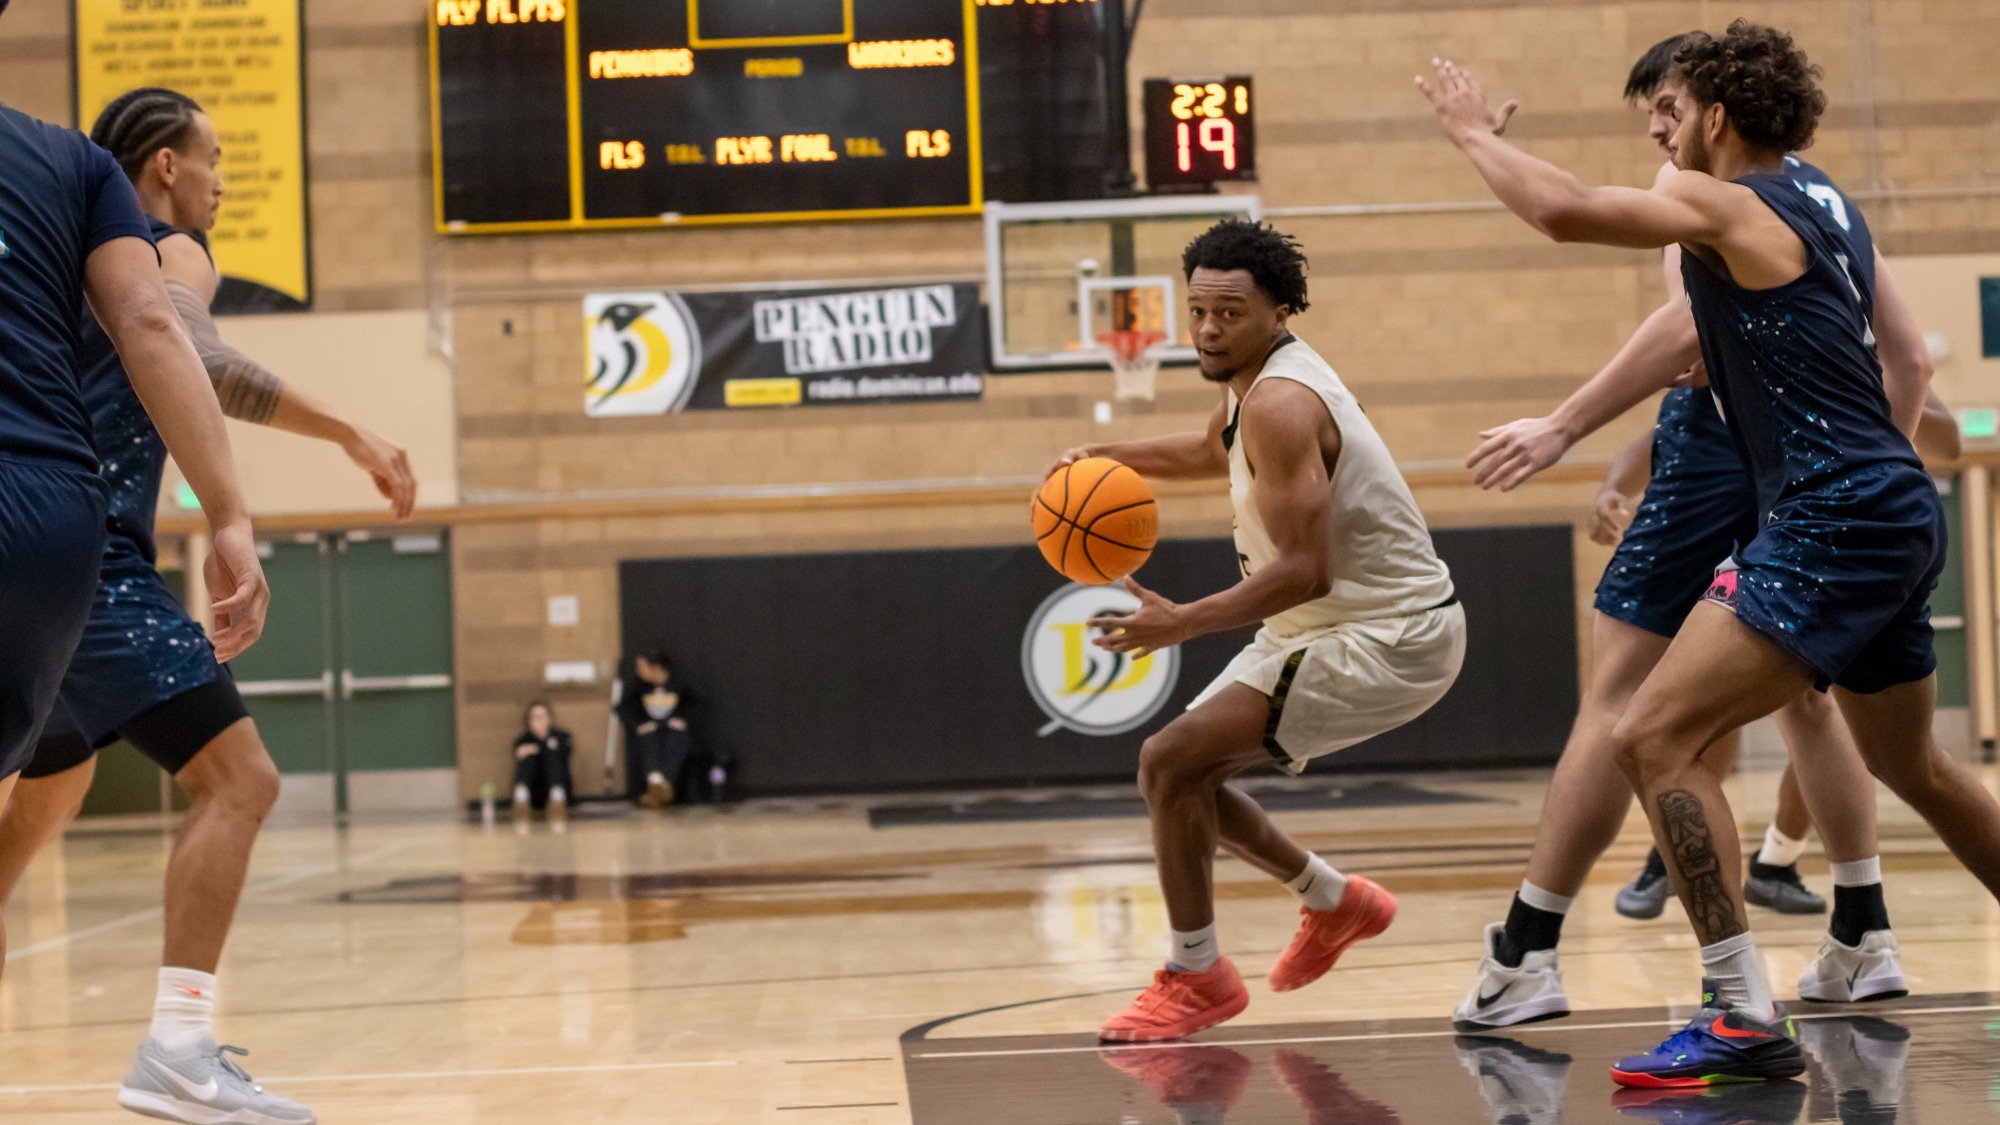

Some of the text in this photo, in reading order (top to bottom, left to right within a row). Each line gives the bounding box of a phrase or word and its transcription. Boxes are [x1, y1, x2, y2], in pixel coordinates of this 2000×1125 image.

[589, 48, 694, 79] PENGUINS
[1171, 83, 1248, 119] 2:21
[600, 141, 645, 169] FLS
[716, 134, 838, 165] PLYR FOUL
[906, 129, 950, 158] FLS
[1177, 117, 1236, 172] 19
[757, 287, 952, 340] PENGUIN
[788, 327, 927, 369] RADIO
